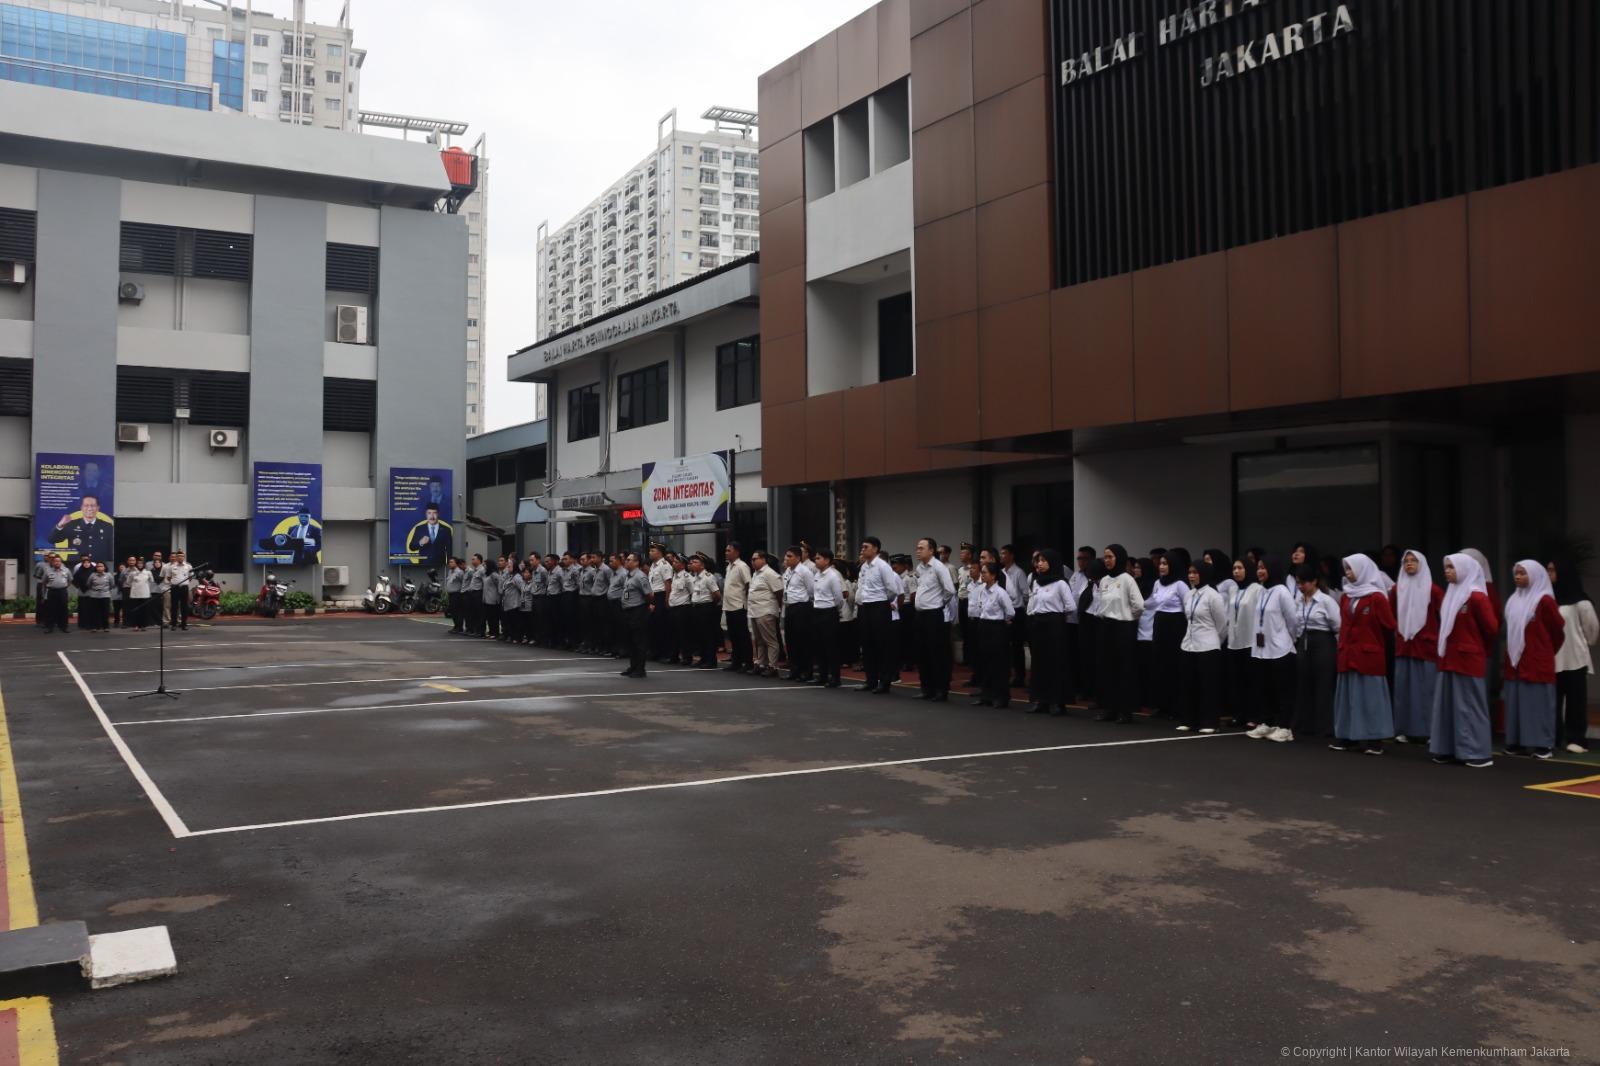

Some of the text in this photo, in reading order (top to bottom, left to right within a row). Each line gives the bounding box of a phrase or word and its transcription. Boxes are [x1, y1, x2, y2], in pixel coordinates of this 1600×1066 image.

[1061, 0, 1259, 86] BALAI HAR
[1200, 4, 1354, 87] JAKARTA
[641, 301, 681, 327] JAKARTA
[653, 481, 715, 502] ZONA INTEGRITAS
